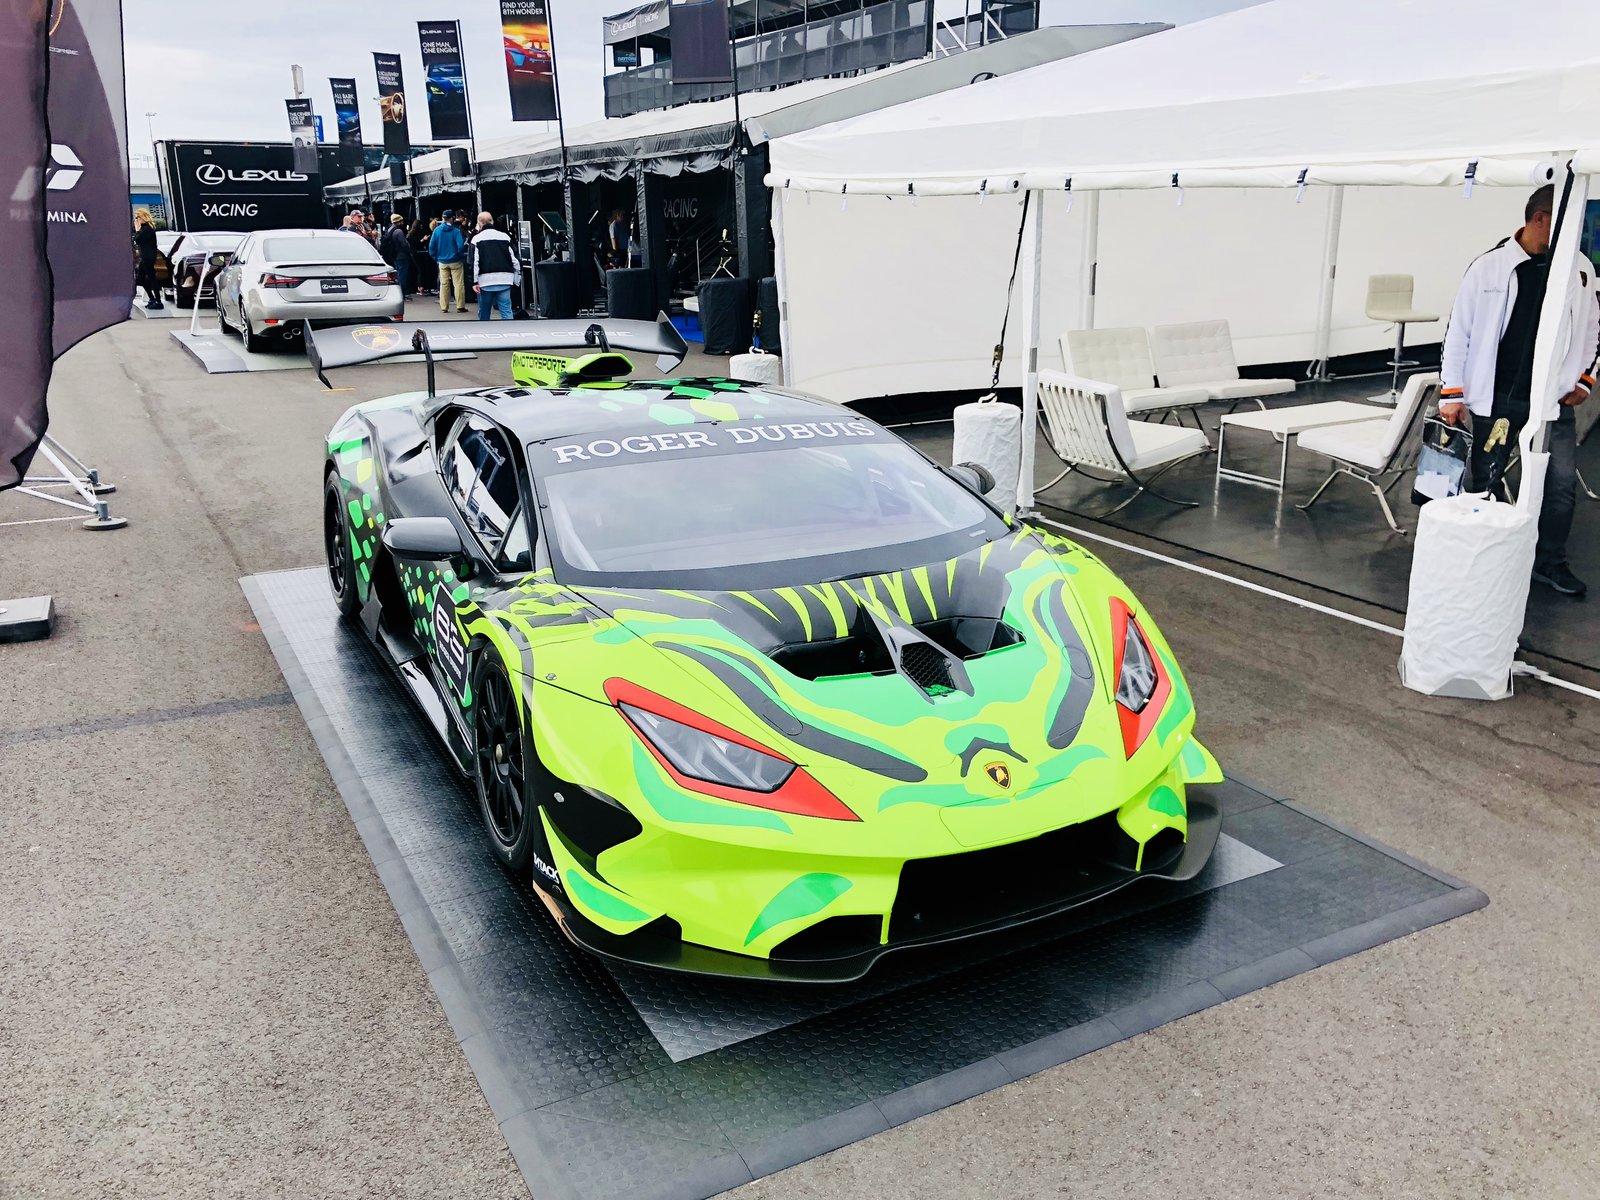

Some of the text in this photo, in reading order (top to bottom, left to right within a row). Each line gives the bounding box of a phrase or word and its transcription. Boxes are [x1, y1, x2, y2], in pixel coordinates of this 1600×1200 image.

[227, 169, 309, 181] LEXUS
[46, 210, 88, 223] MINA
[202, 203, 258, 217] RACING
[552, 422, 876, 464] ROGER DUBUIS
